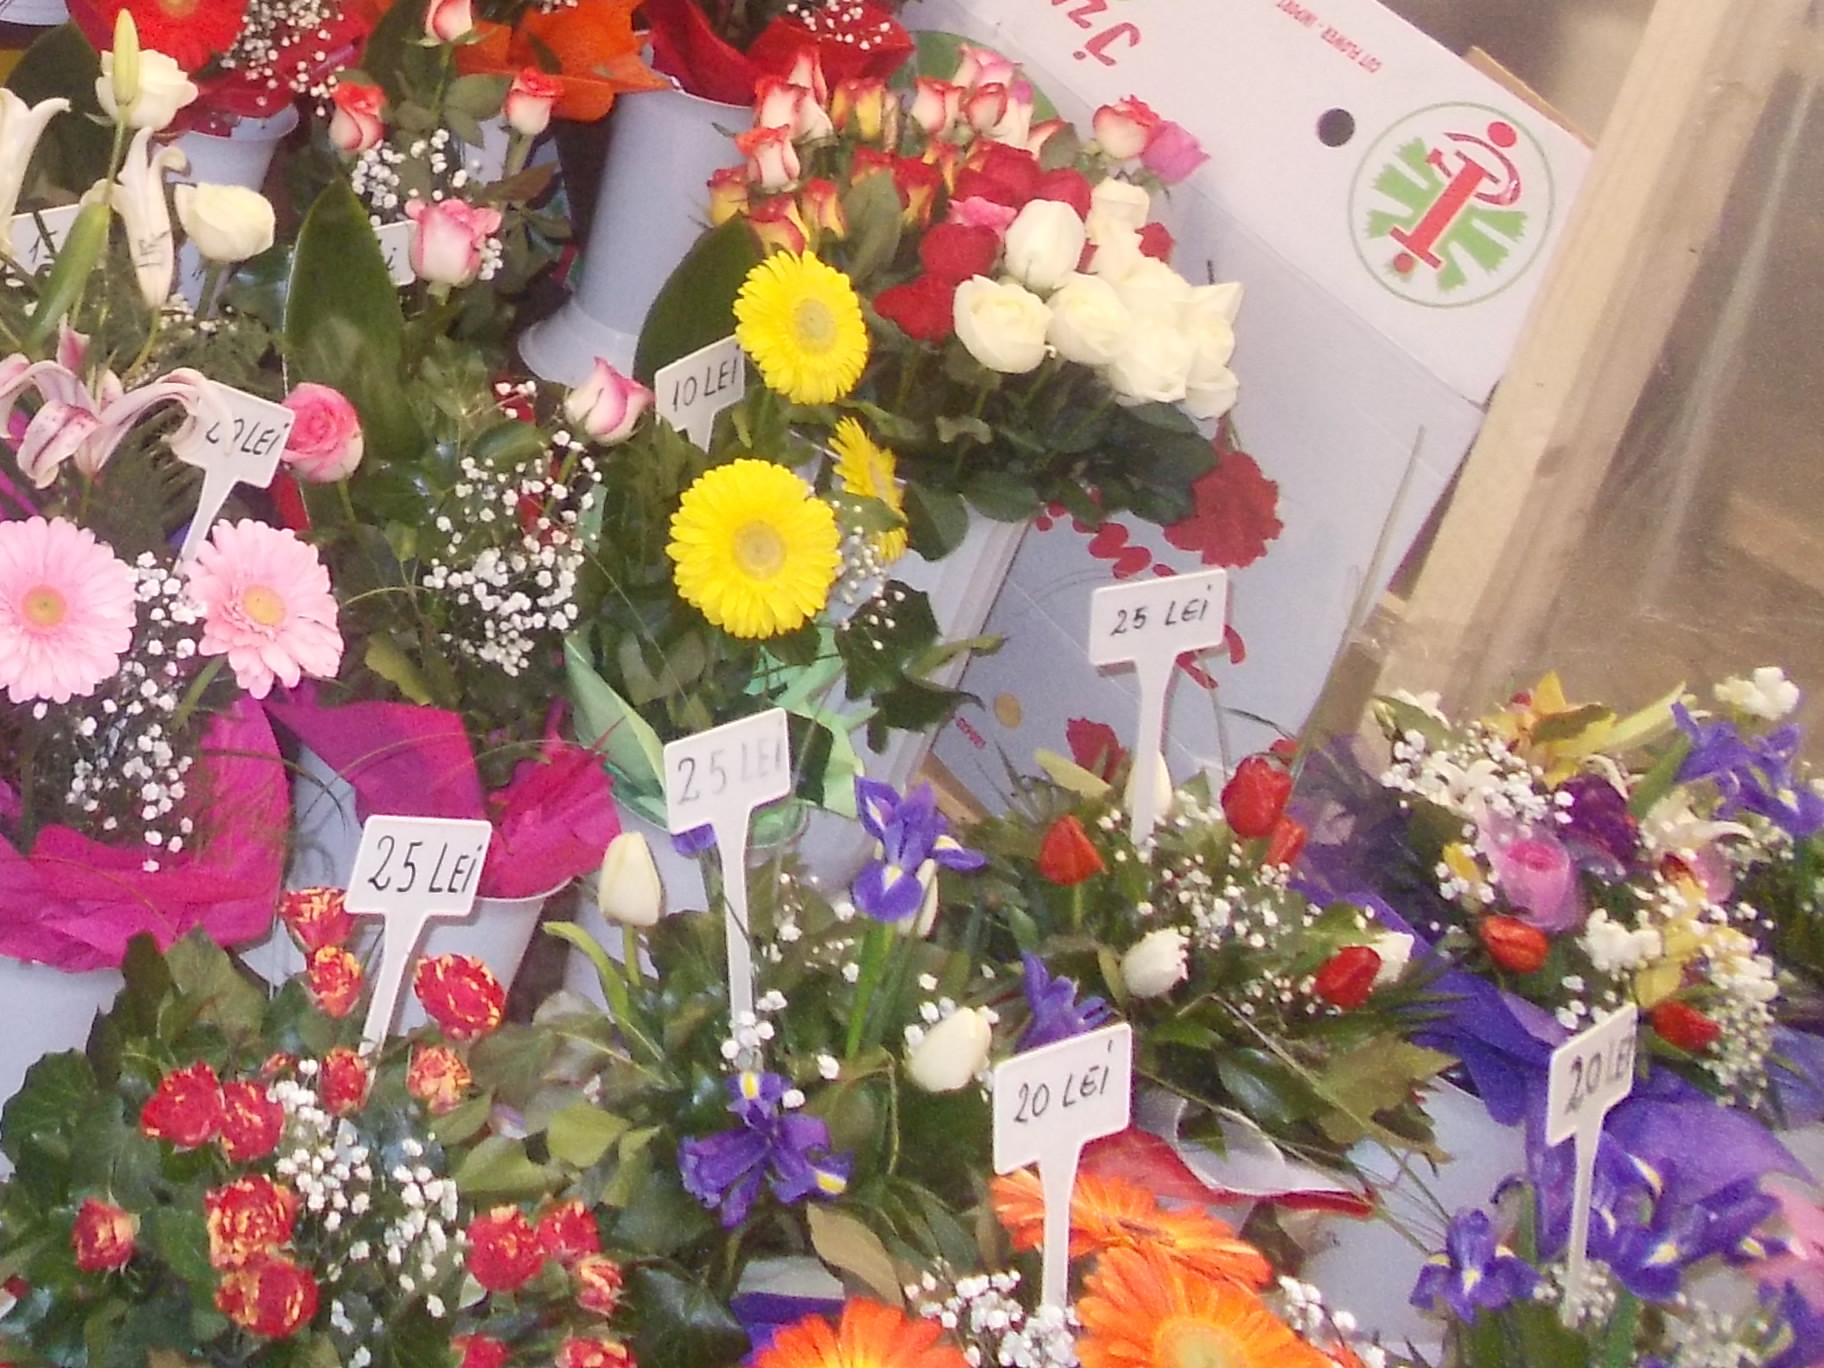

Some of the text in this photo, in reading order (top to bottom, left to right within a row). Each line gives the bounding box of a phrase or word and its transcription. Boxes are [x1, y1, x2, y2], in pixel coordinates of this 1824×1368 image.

[672, 375, 697, 412] 10
[1109, 605, 1148, 637] 25
[677, 748, 727, 806] 25
[367, 834, 424, 893] 25
[1013, 1082, 1050, 1124] 20
